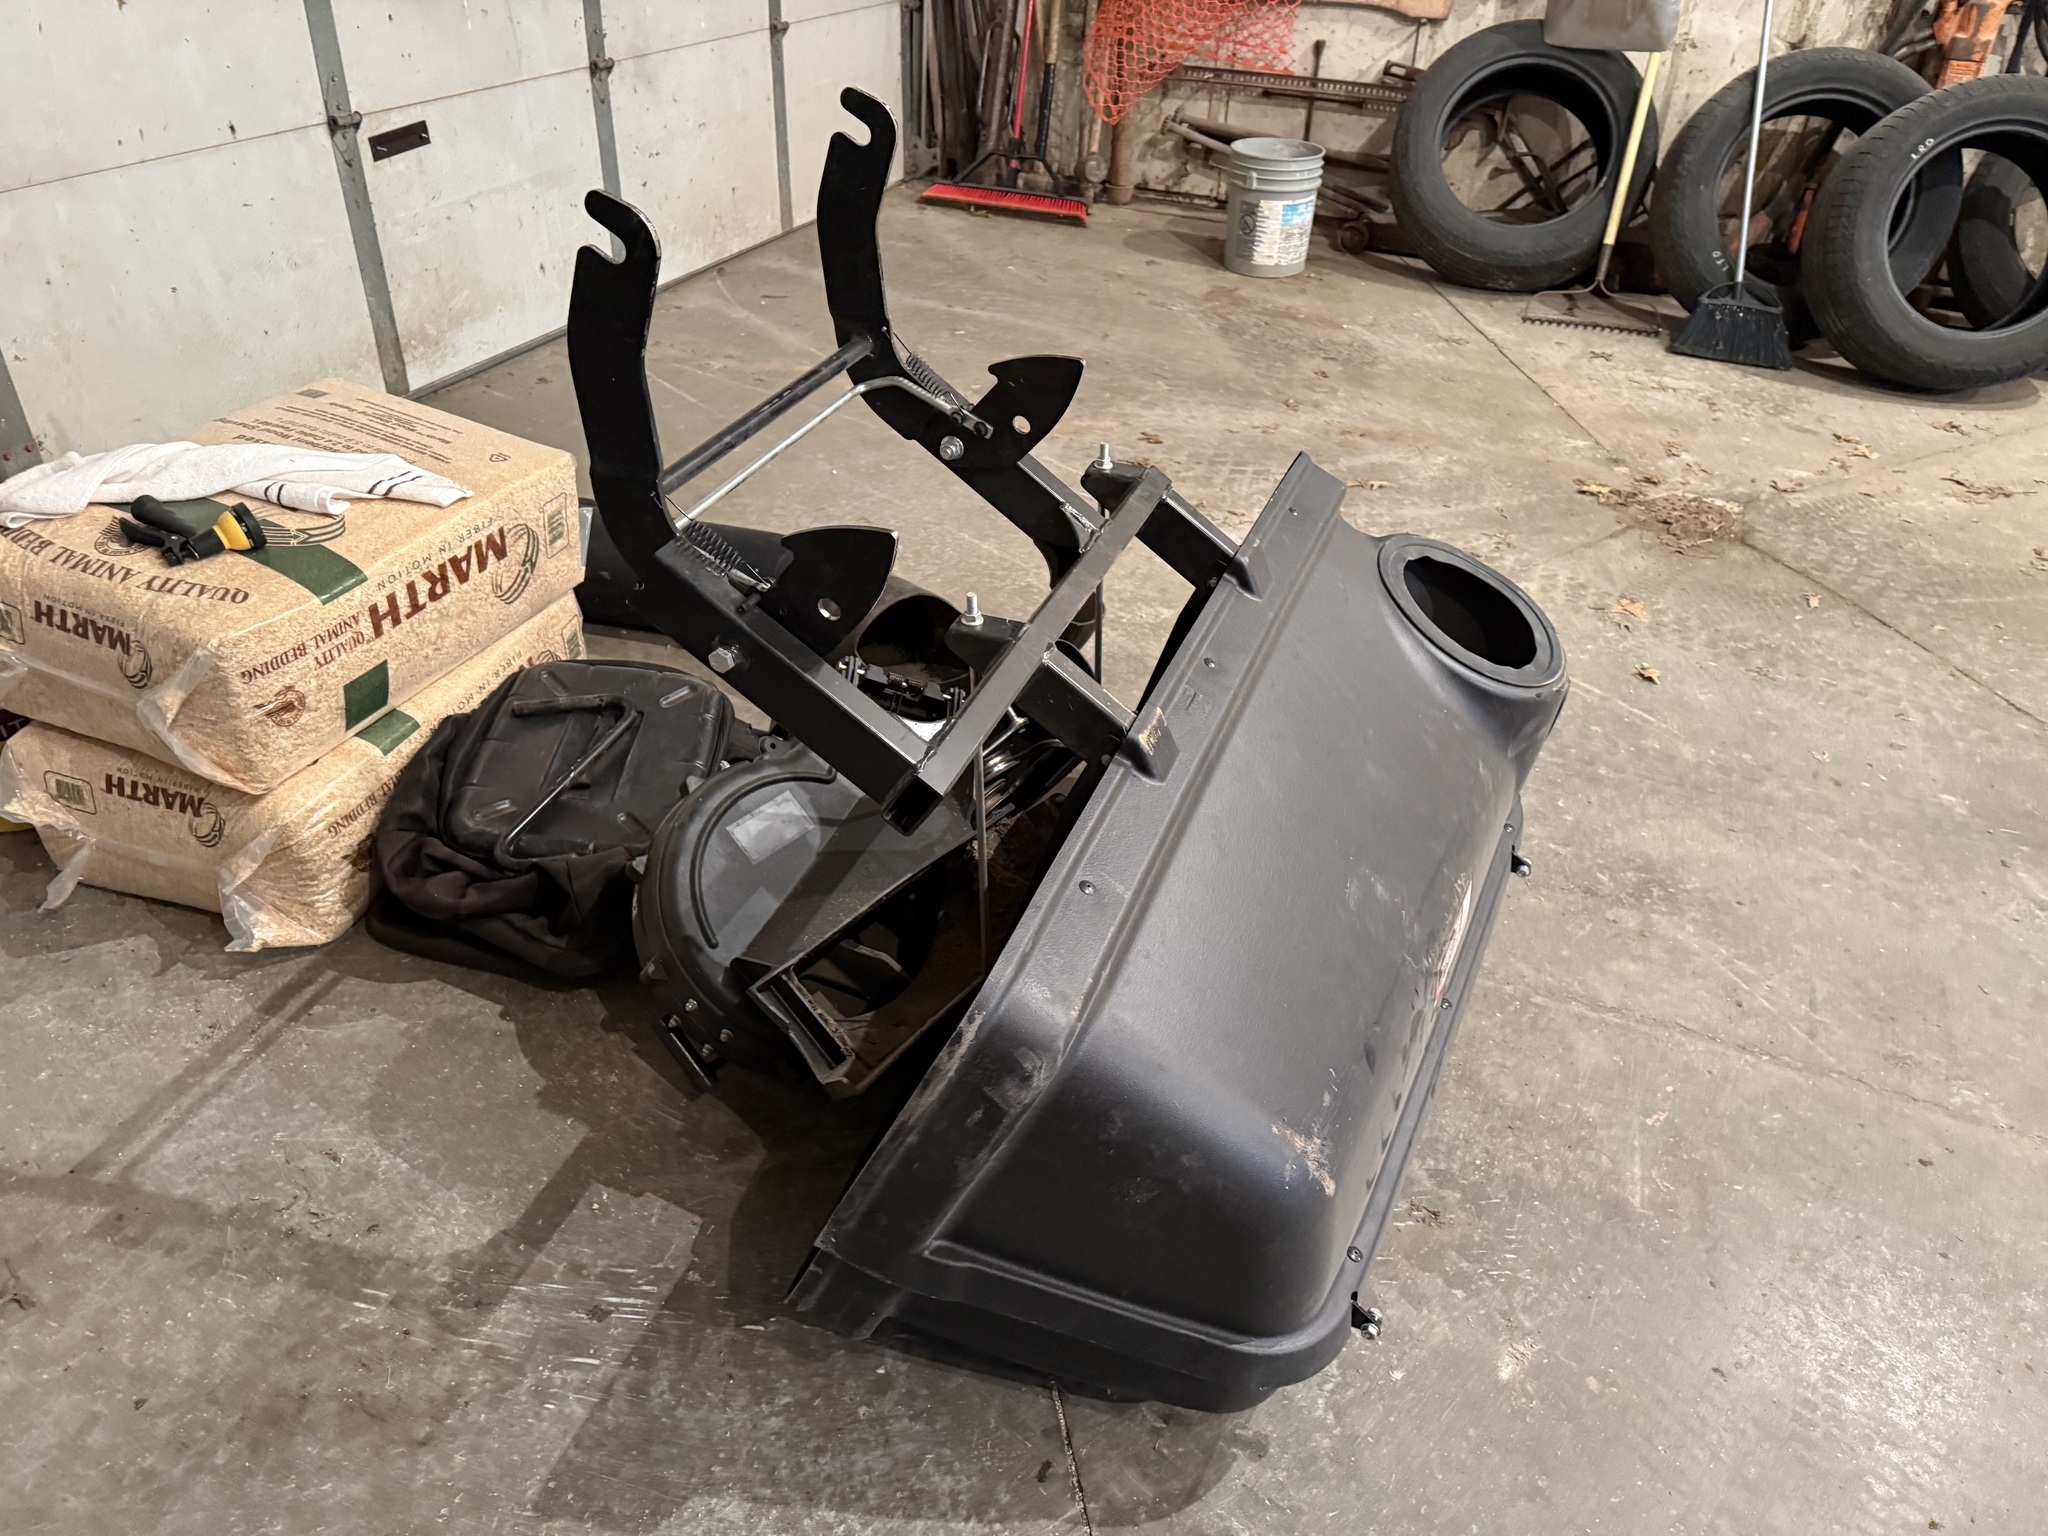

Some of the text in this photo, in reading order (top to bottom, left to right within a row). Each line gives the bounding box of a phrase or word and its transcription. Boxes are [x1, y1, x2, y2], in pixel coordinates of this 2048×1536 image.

[0, 527, 249, 604] QUALITY ANIMAL BEDD
[376, 516, 493, 591] FIBER IN MOTION
[42, 594, 82, 612] MOTION
[367, 526, 508, 640] MARTH
[33, 600, 131, 655] MARTH
[240, 611, 360, 684] ANIMAL BEDDING
[313, 631, 365, 669] QUALITY
[104, 773, 204, 817] MARTH
[326, 792, 377, 839] BEDDING
